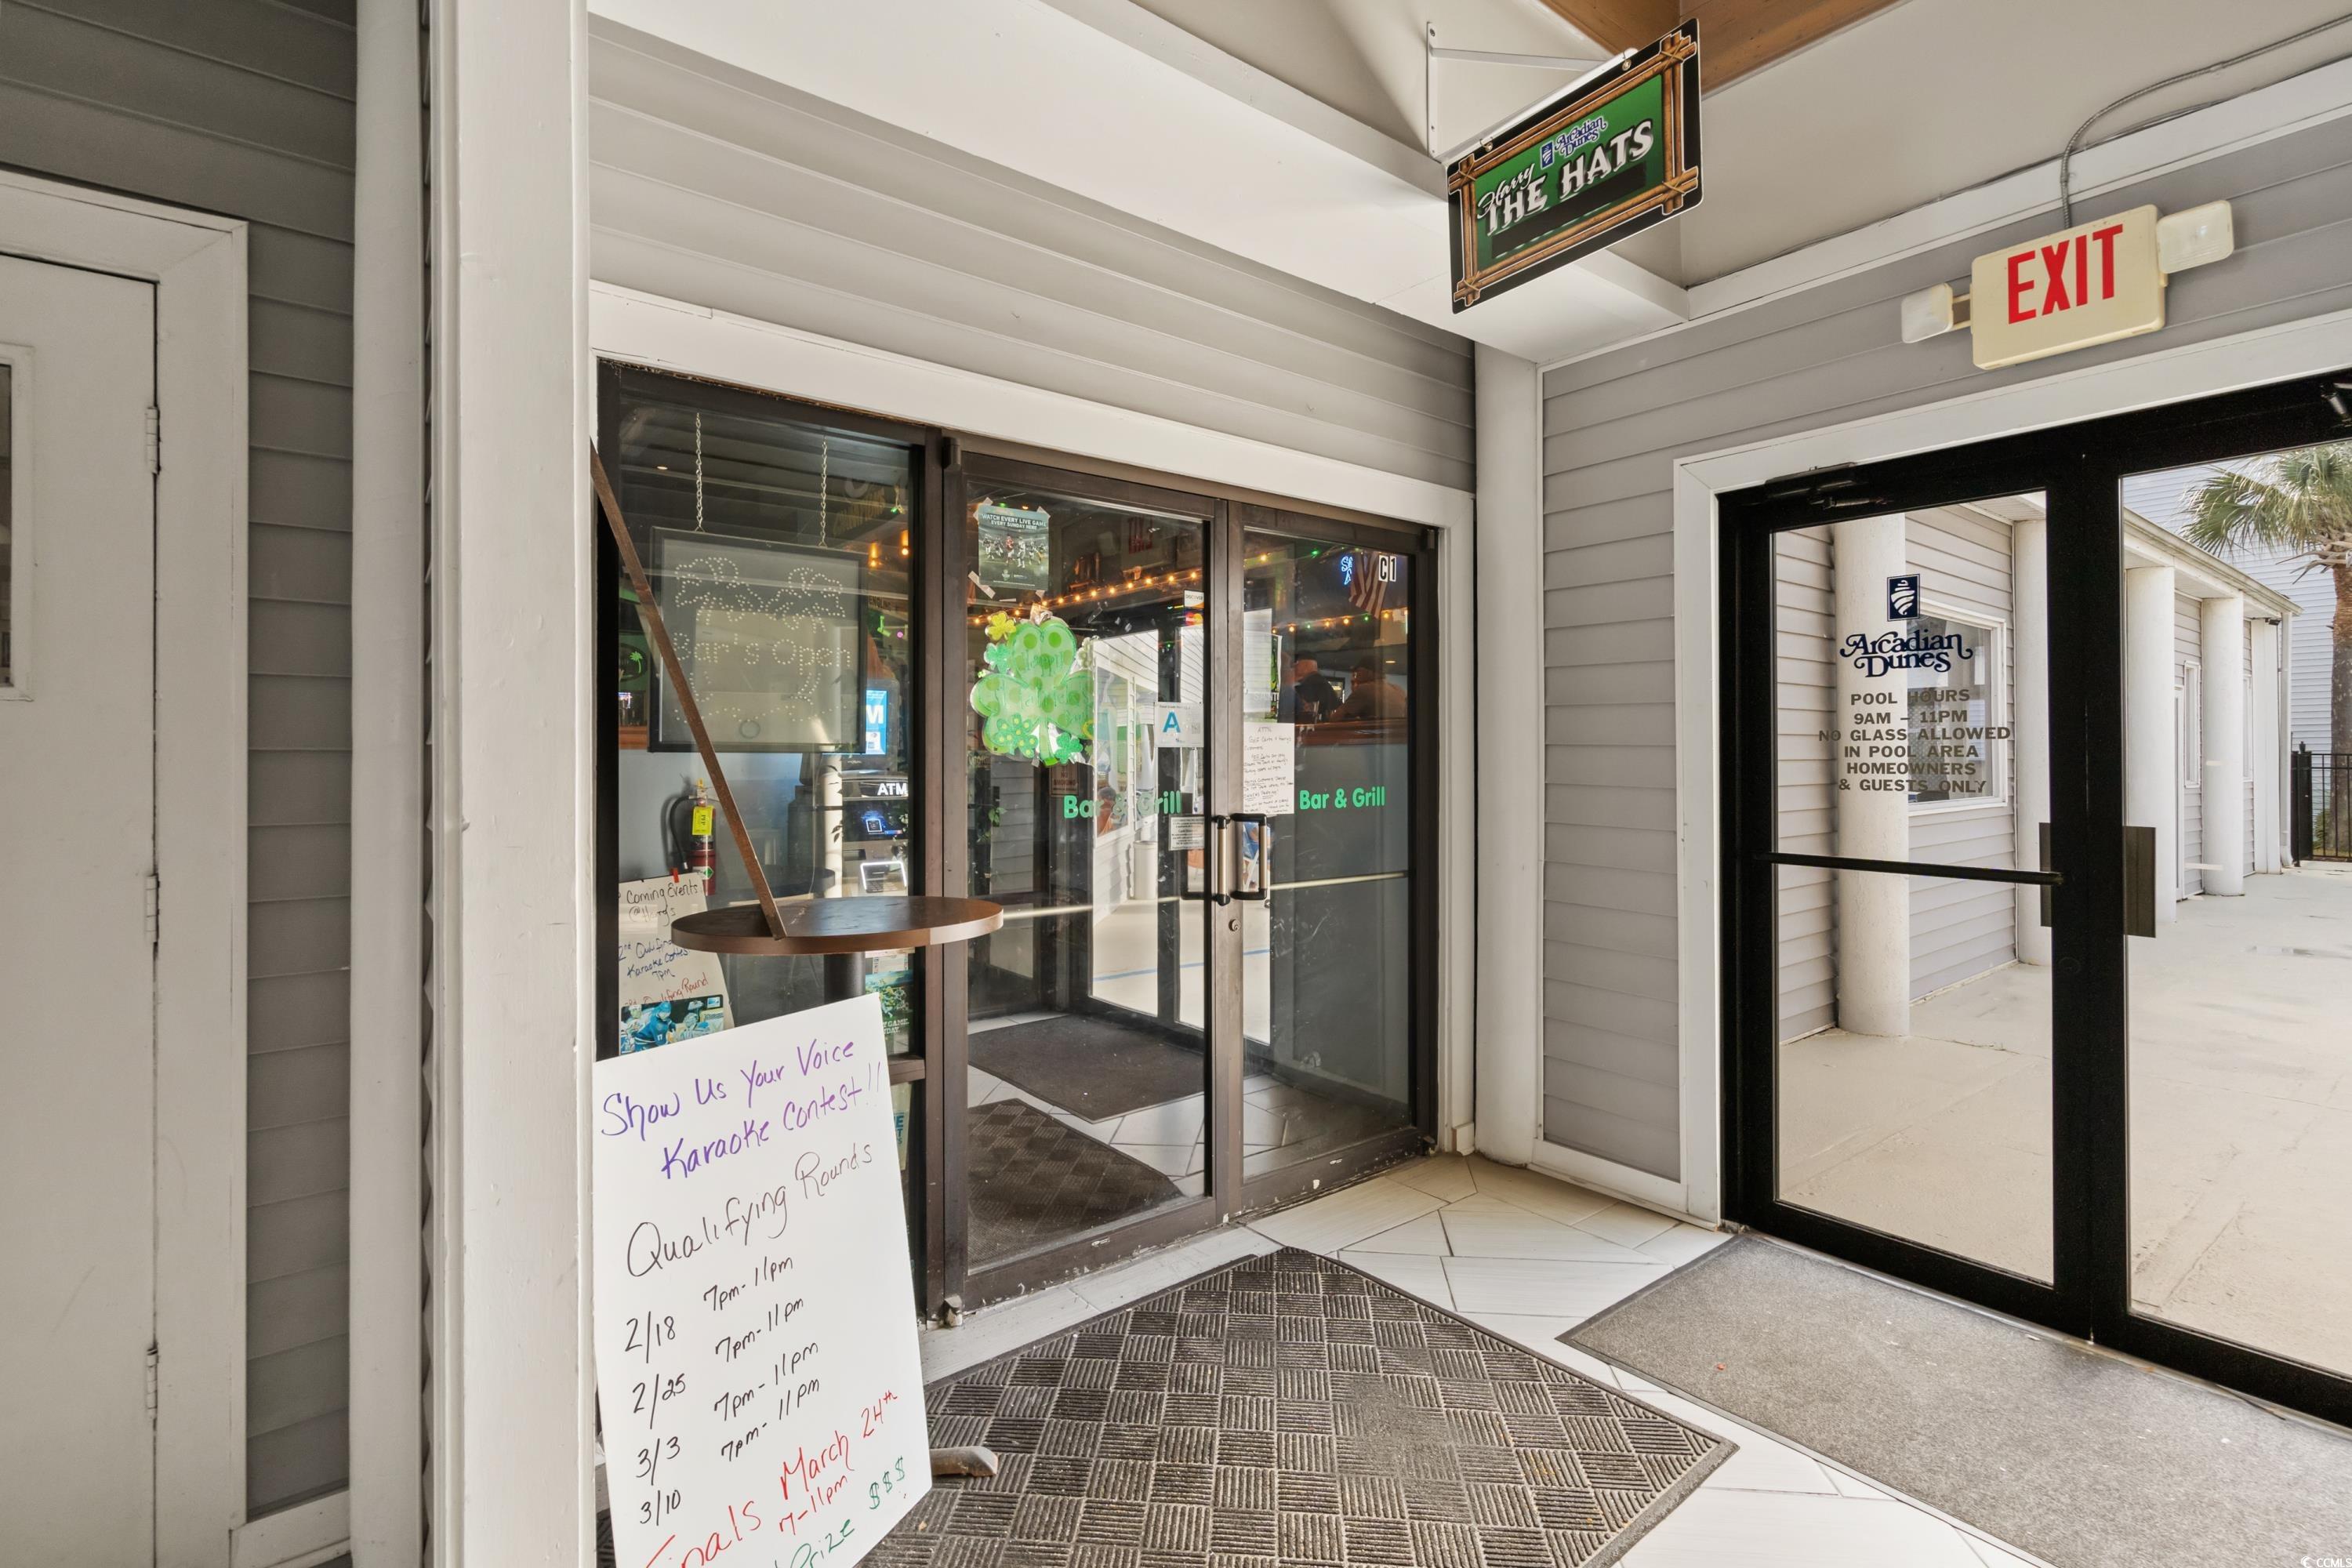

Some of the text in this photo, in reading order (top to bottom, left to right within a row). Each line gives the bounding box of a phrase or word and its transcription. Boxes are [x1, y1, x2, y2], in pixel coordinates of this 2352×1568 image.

[1554, 115, 1608, 151] Arcadian
[1559, 129, 1599, 157] Dunes
[1485, 118, 1654, 236] THE HATS
[1478, 163, 1535, 220] Harry
[2008, 224, 2123, 325] EXIT
[1000, 514, 1018, 523] EVERY
[1840, 629, 1973, 660] Arcadian
[1854, 651, 1951, 677] Dunes
[1850, 688, 1970, 706] POOL HOURS
[1163, 710, 1181, 733] A
[1854, 712, 1891, 725] 9AM
[1920, 710, 1968, 724] 11PM
[1819, 726, 2011, 742] NO GLASS ALLOWED
[1844, 745, 1979, 758] IN POOL AREA
[1846, 762, 1976, 775] HOMEOWNERS
[877, 782, 908, 796] ATM
[1299, 789, 1329, 810] Bar
[1334, 789, 1347, 809] &
[1352, 786, 1385, 808] Grill
[1838, 779, 1987, 793] & GUESTS ONLY
[626, 887, 667, 905] Coming
[668, 879, 699, 898] Events
[627, 955, 663, 978] Karaoke
[681, 971, 710, 993] Round
[601, 1038, 855, 1142] Show Us Your Voice
[660, 1119, 770, 1180] Karaoke
[626, 1142, 873, 1278] Qualifying Rounds
[625, 1311, 676, 1363] 2/18
[632, 1373, 686, 1429] 2/25
[780, 1429, 855, 1500] March
[861, 1390, 898, 1439] 24th
[635, 1436, 681, 1486] 3/3
[639, 1490, 681, 1526] 3/10
